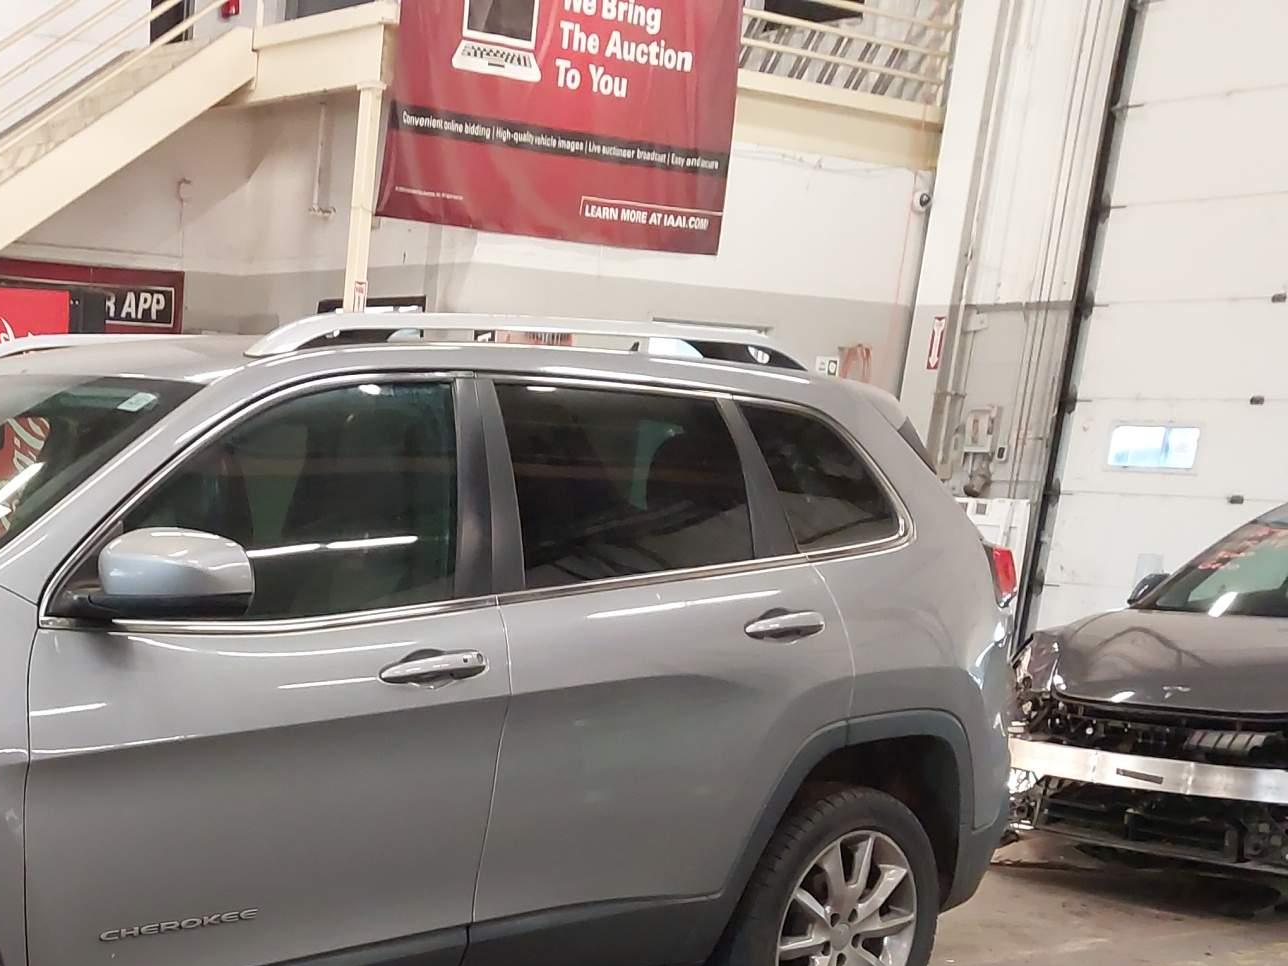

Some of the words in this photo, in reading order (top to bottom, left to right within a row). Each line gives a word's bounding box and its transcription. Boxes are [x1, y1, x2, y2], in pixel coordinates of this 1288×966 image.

[601, 0, 662, 35] Bring
[560, 20, 600, 55] The
[604, 30, 693, 72] Auction
[555, 58, 582, 90] To
[588, 63, 628, 98] You
[402, 110, 443, 129] Convenient
[443, 119, 463, 134] online
[464, 121, 491, 140] bidding
[496, 127, 534, 145] High-quality
[534, 134, 557, 148] vehicle
[558, 137, 583, 152] images
[588, 140, 601, 153] Live
[636, 148, 667, 164] broadcast
[584, 204, 618, 220] LEARN
[621, 208, 647, 224] MORE
[648, 212, 663, 226] AT
[120, 291, 166, 320] APP
[99, 908, 259, 941] CHEROKEE
